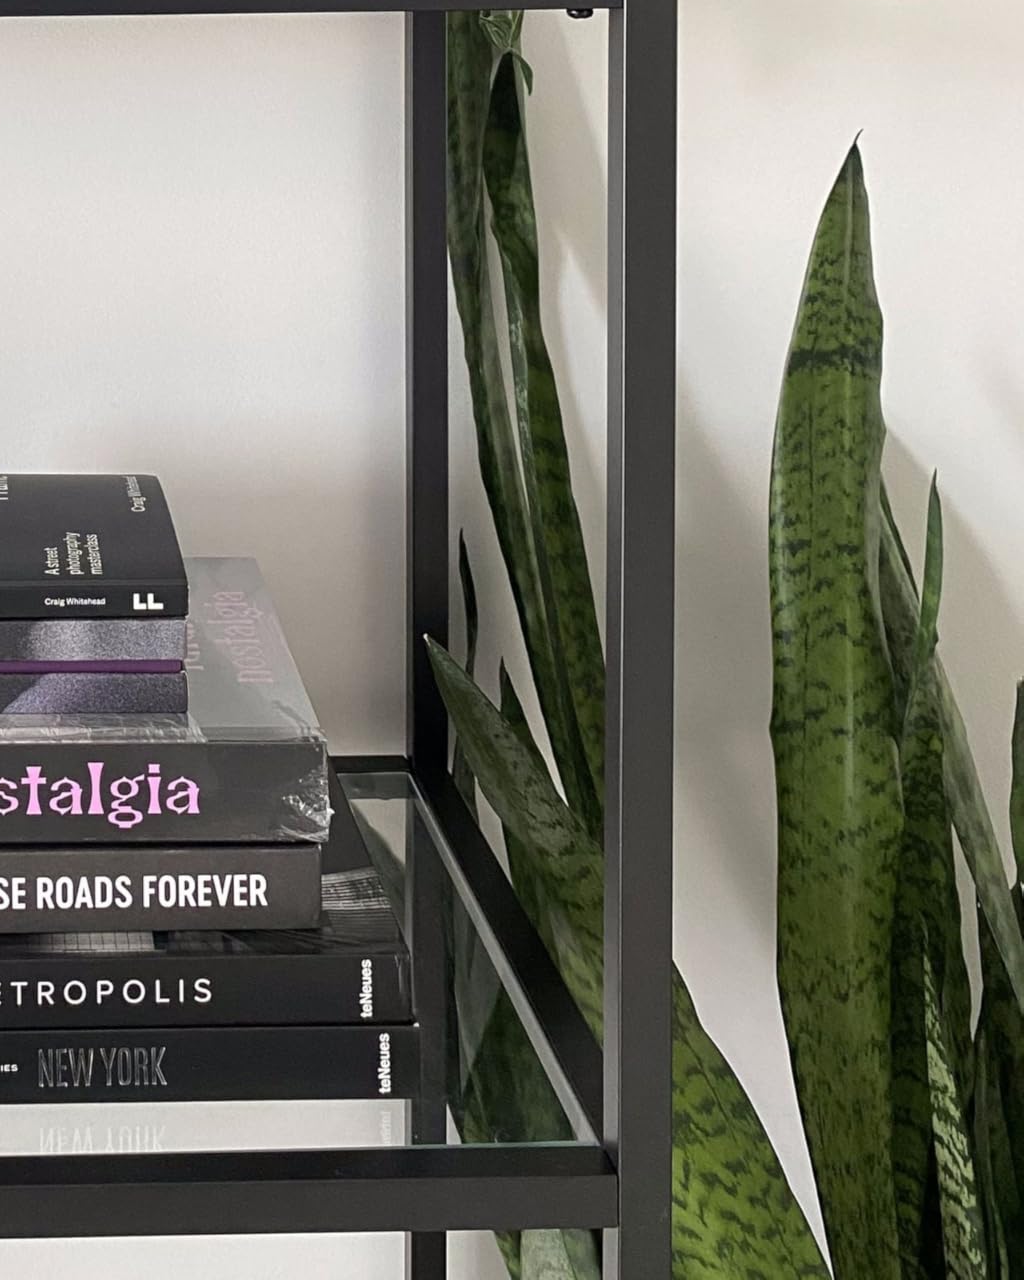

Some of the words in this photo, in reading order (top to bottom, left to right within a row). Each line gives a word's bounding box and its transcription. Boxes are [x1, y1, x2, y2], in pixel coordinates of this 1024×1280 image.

[131, 496, 146, 512] Craig
[44, 547, 60, 567] street
[44, 568, 60, 576] A
[64, 531, 84, 576] photography
[85, 533, 103, 575] masterclass
[44, 597, 65, 607] Craig
[66, 597, 106, 606] Whitehead
[204, 591, 274, 684] nostalgia
[36, 876, 133, 909] ROADS
[142, 874, 268, 907] FOREVER
[359, 959, 373, 1018] teNeues
[37, 1047, 94, 1088] NEW
[100, 1046, 167, 1086] YORK
[378, 1033, 391, 1094] teNeues
